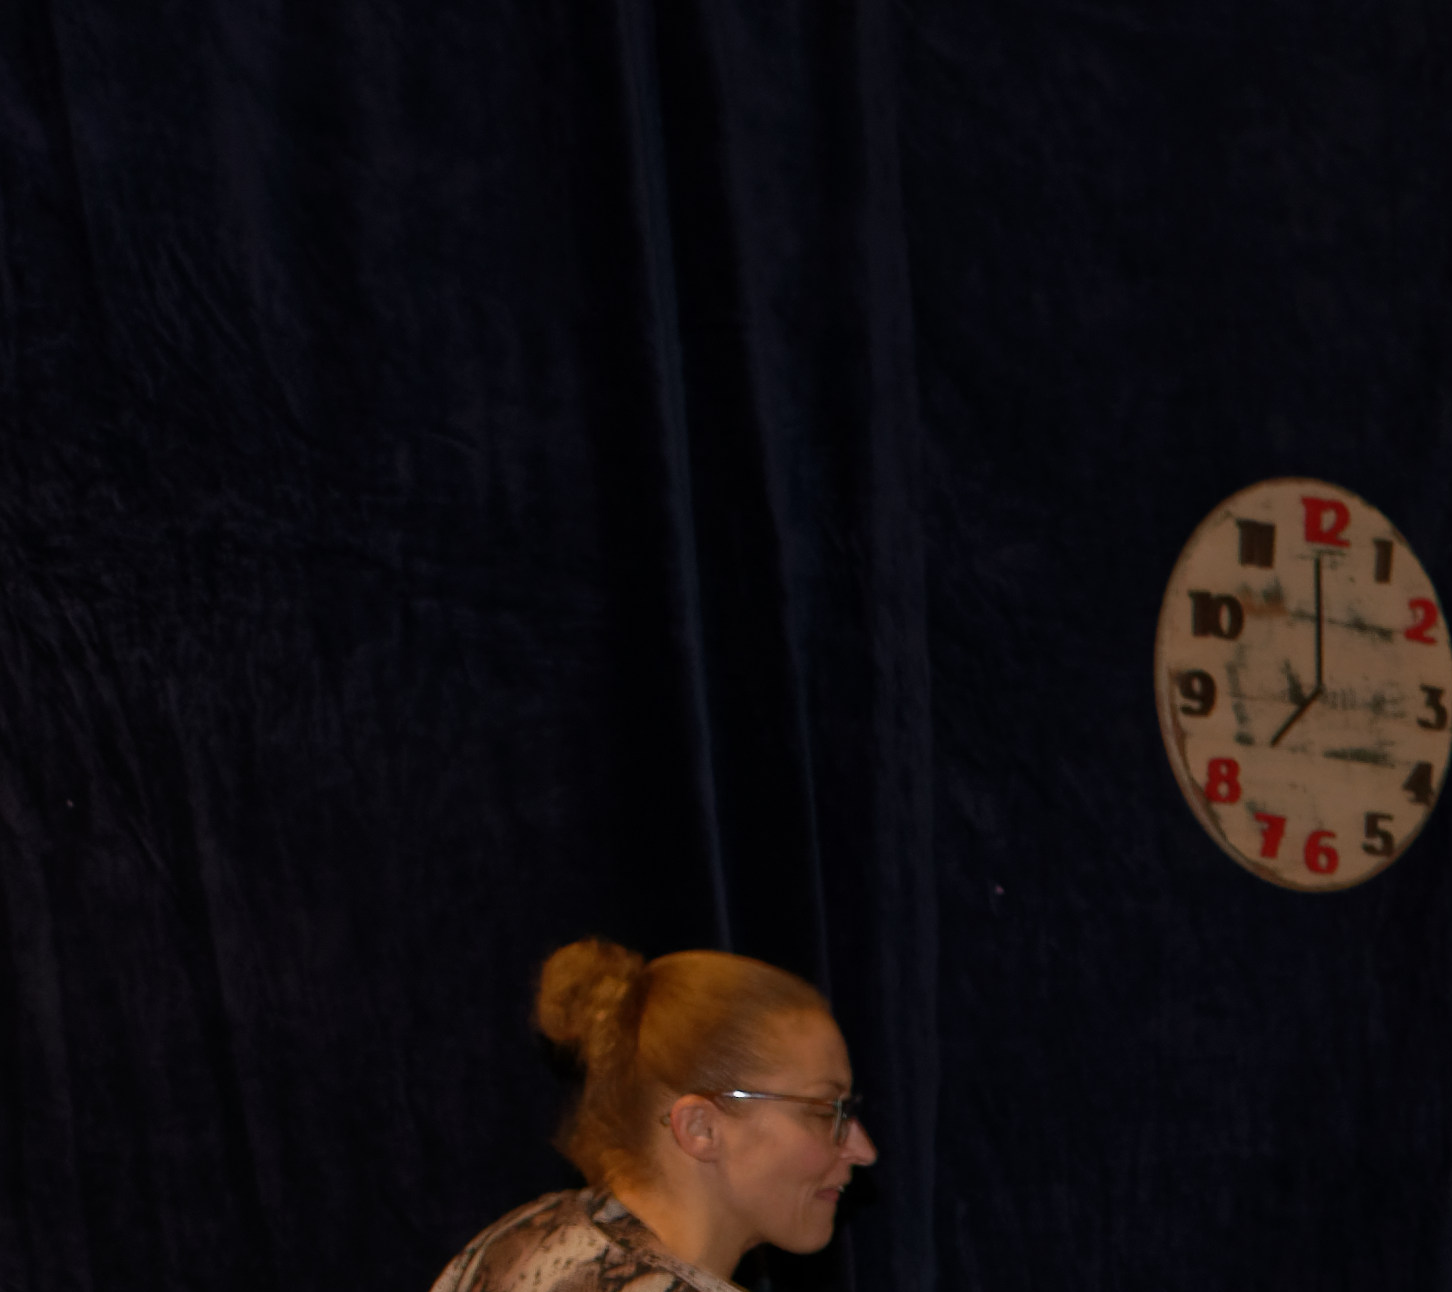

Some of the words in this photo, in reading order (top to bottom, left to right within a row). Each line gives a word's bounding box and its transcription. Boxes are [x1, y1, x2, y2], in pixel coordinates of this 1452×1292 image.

[1300, 496, 1350, 547] 12
[1372, 538, 1393, 583] 1
[1188, 590, 1244, 640] 10
[1404, 598, 1438, 645] 2
[1179, 669, 1217, 718] 9
[1417, 684, 1447, 730] 3
[1204, 758, 1241, 803] 8
[1403, 762, 1434, 806] 4
[1254, 812, 1286, 858] 7
[1304, 830, 1338, 874] 6
[1362, 812, 1394, 856] 5
